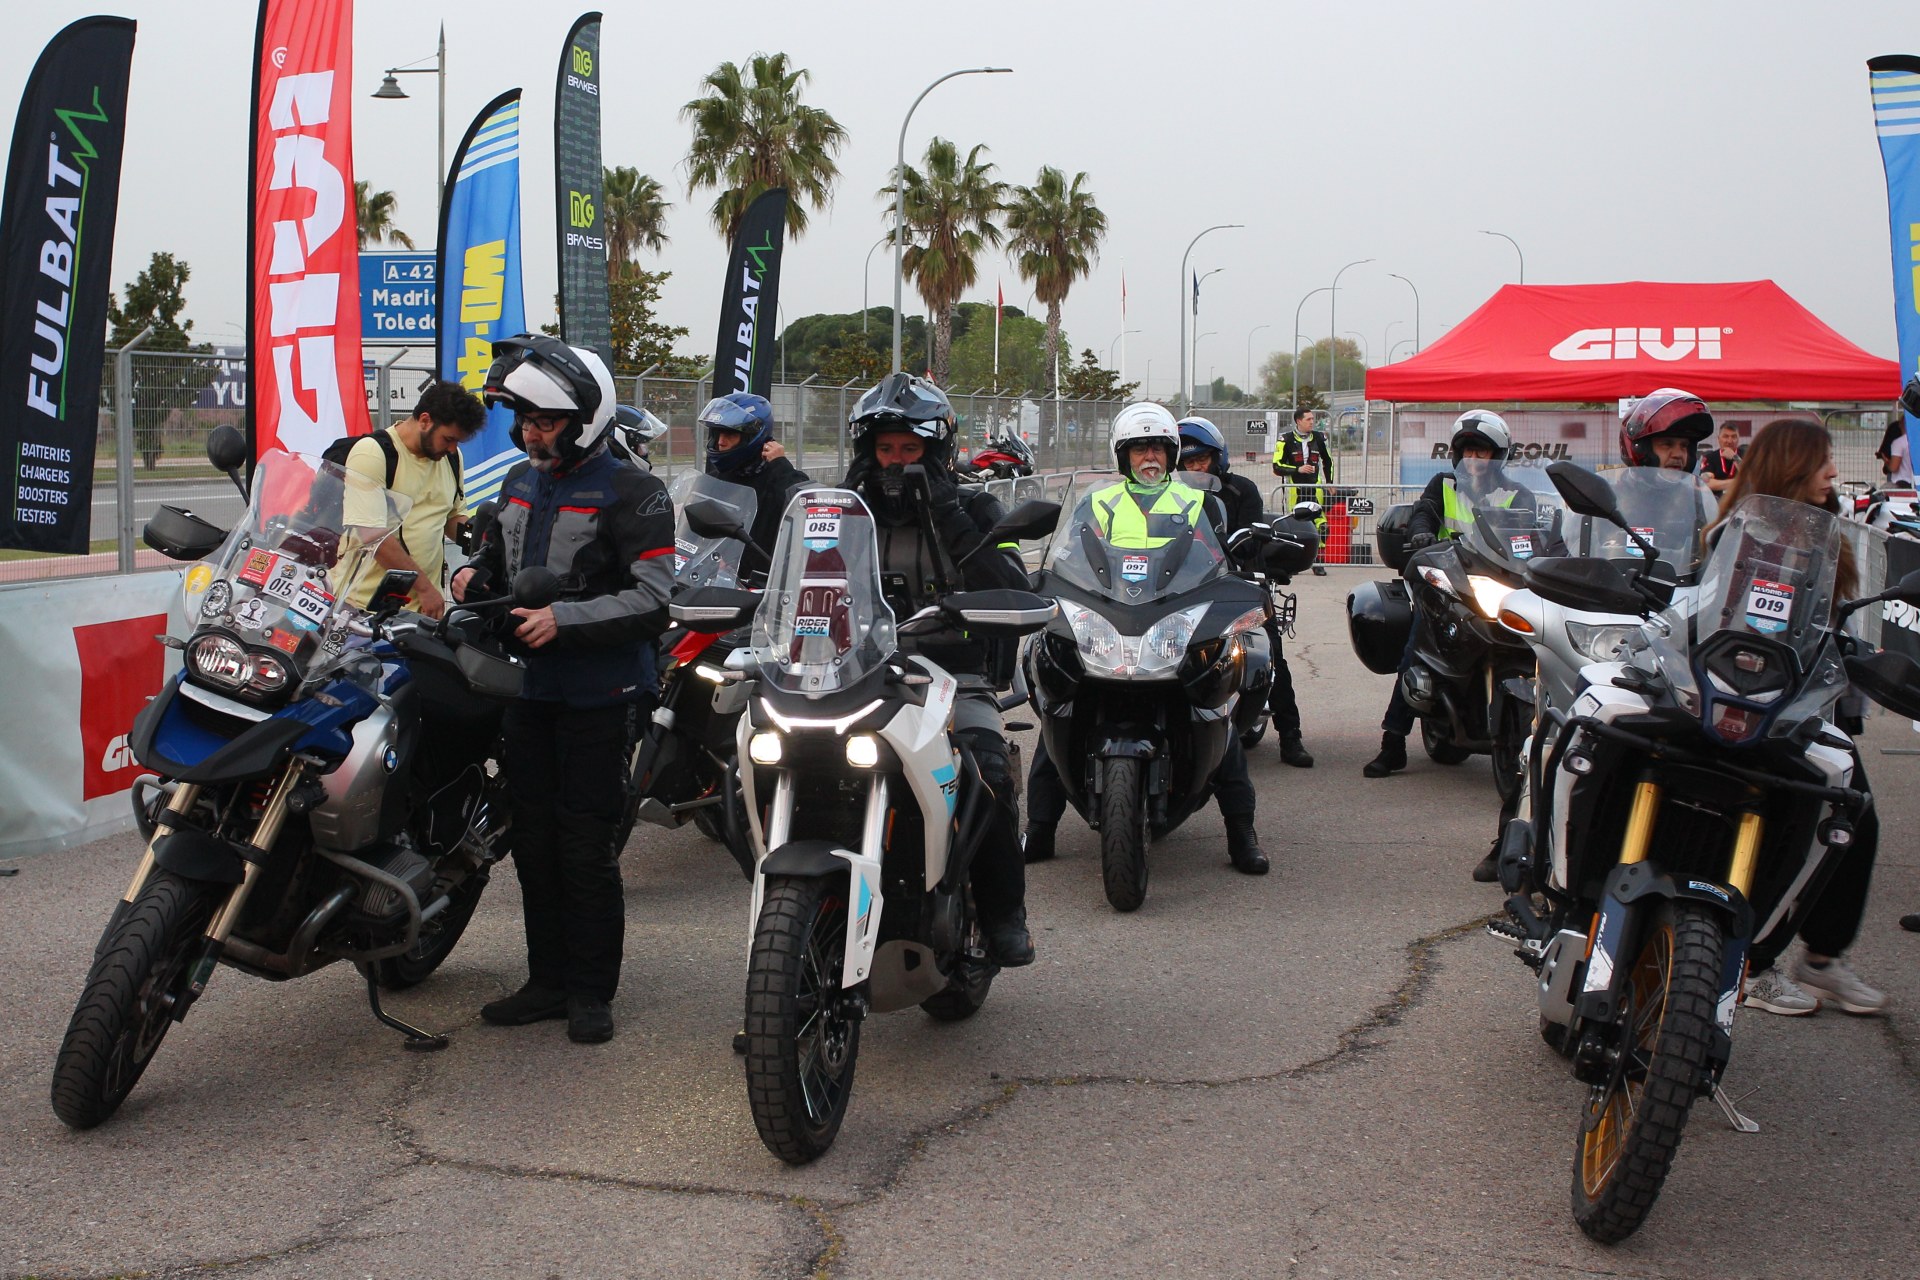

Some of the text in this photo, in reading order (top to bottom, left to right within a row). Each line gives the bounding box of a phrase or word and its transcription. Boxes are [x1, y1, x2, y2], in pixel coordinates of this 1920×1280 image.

[567, 75, 598, 95] BRAKES
[269, 70, 347, 471] GIVI
[387, 264, 435, 280] A-42
[27, 144, 82, 419] FULBAT
[733, 266, 760, 394] ULBAT
[1549, 327, 1721, 361] GIVI
[21, 442, 71, 462] BATTERIES
[20, 464, 70, 484] CHARGERS
[18, 486, 68, 505] BOOSTERS
[1352, 498, 1370, 507] AMS
[16, 507, 57, 525] TESTERS
[809, 522, 835, 532] 085
[269, 577, 295, 598] 015
[298, 596, 324, 618] 091
[1755, 597, 1785, 613] 019
[798, 618, 828, 627] RIDER
[798, 626, 826, 635] SOUL
[324, 640, 341, 652] FUGA
[102, 733, 139, 772] GI
